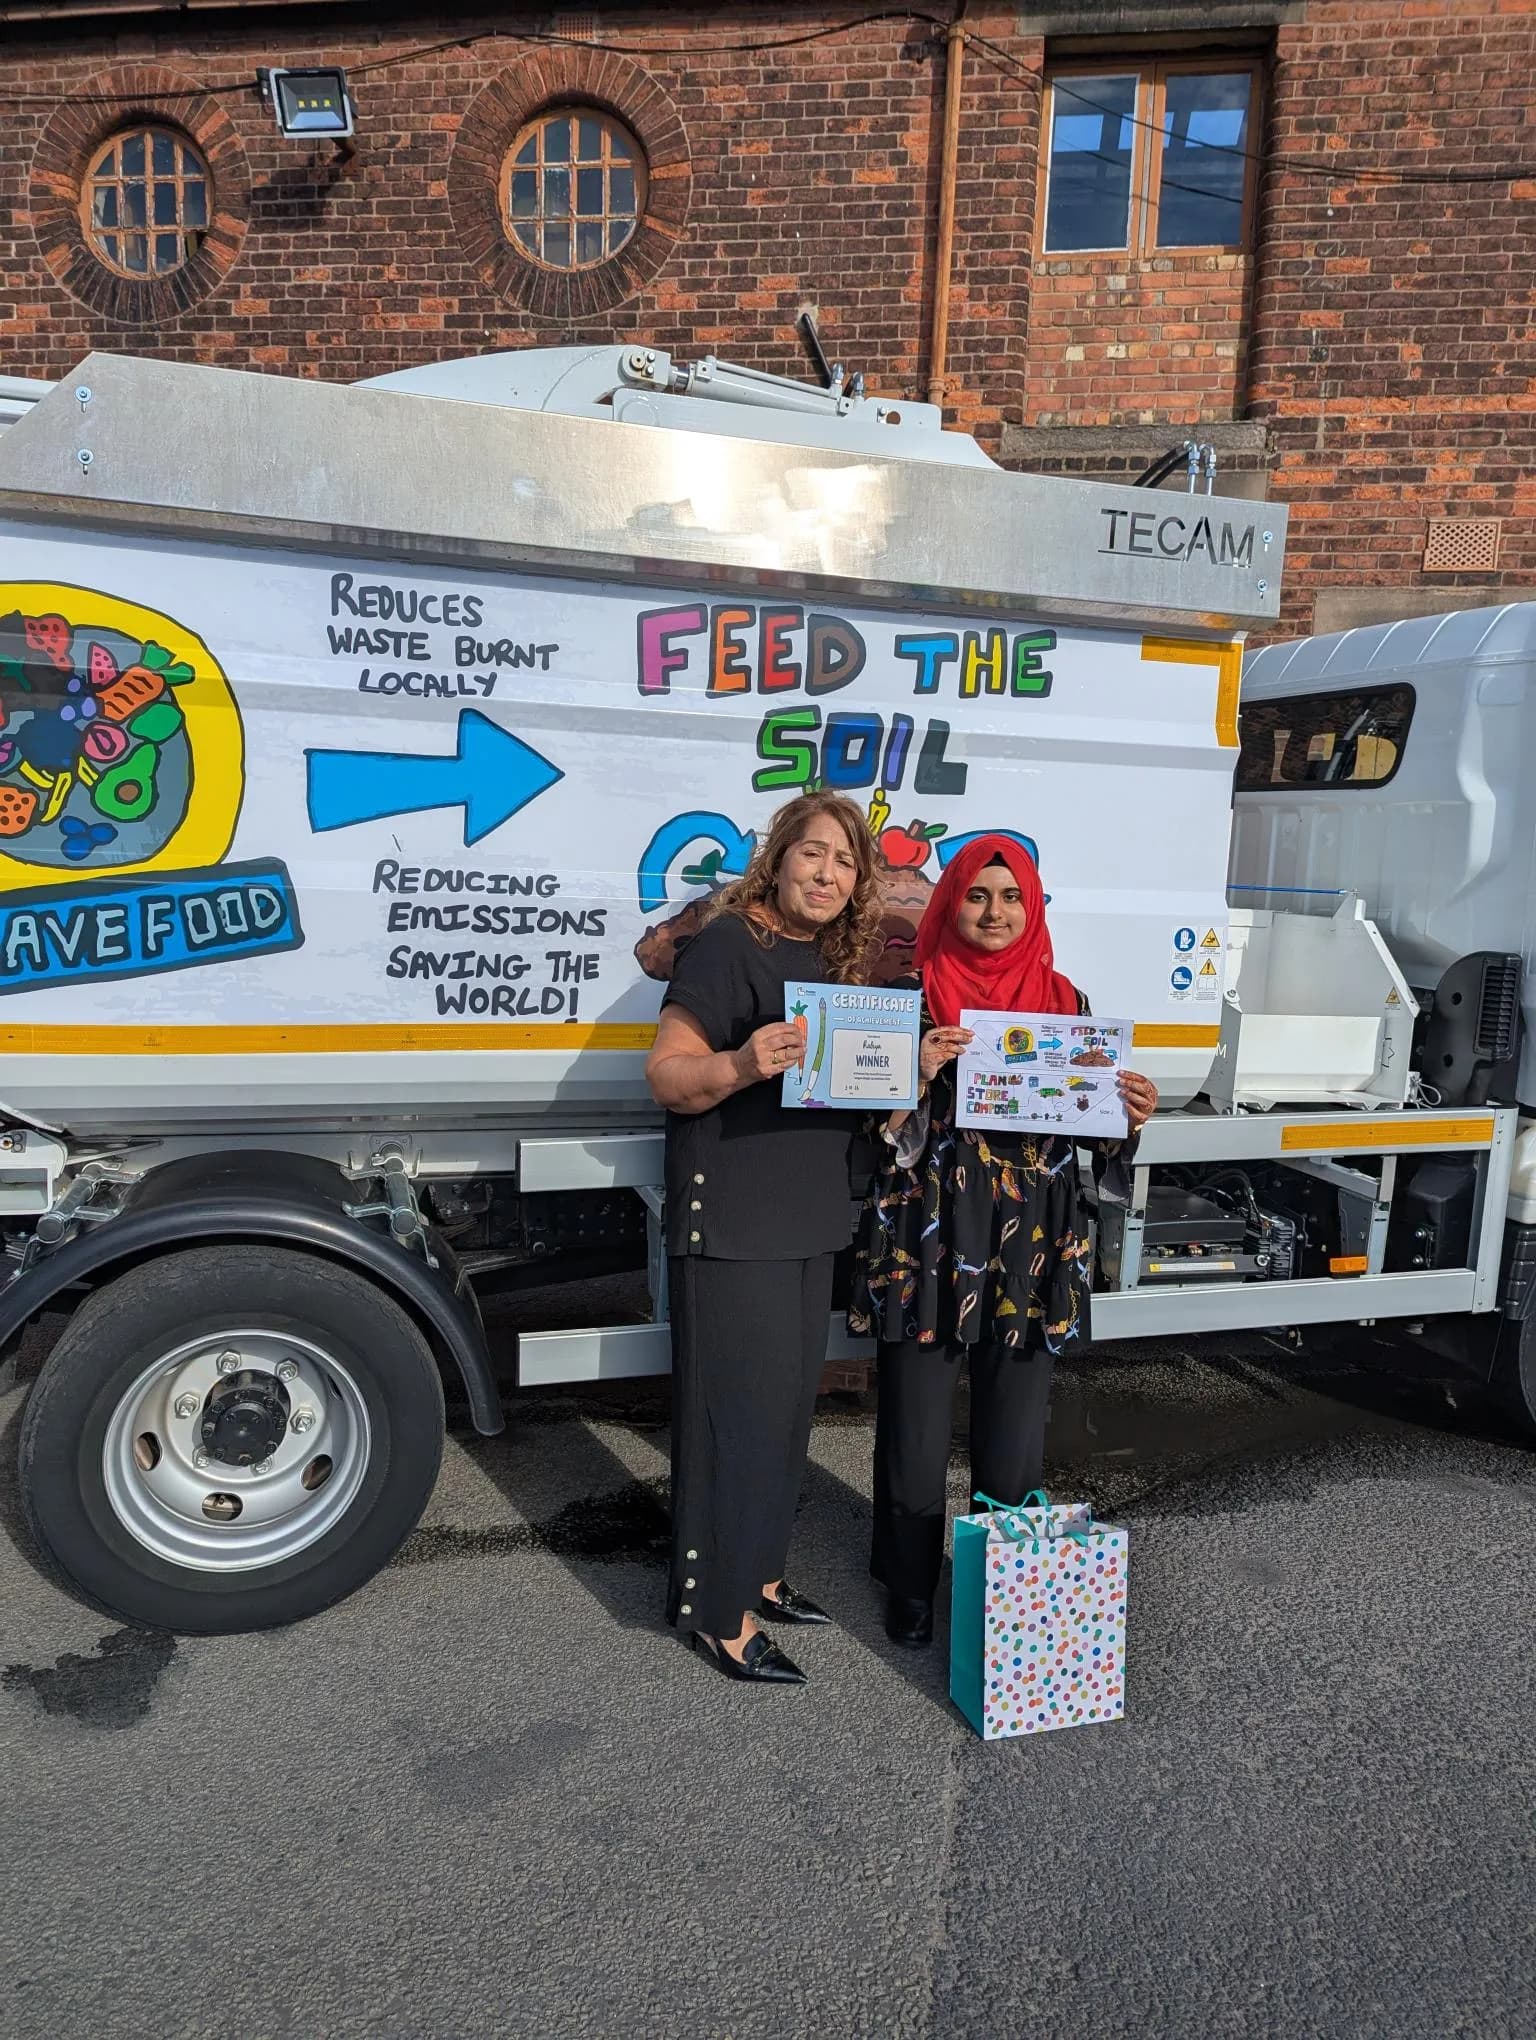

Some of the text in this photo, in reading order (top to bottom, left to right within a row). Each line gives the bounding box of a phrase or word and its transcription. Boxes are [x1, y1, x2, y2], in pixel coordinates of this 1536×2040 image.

[1100, 508, 1256, 568] TECAM
[331, 573, 484, 628] REDUCES
[327, 625, 559, 671] WASTE BURNT
[637, 602, 1057, 699] FEED THE
[359, 669, 498, 697] LOCALLY
[751, 704, 968, 795] SOIL
[372, 860, 560, 898] REDUCING
[143, 885, 284, 955] FOOD
[387, 901, 608, 936] EMISSIONS
[386, 945, 600, 984] SAVING THE
[435, 984, 579, 1023] WORLD!
[832, 992, 915, 1013] CERTIFICATE
[855, 1055, 890, 1068] WINNER
[973, 1073, 1007, 1086] PLAN
[967, 1086, 1008, 1101] STORE
